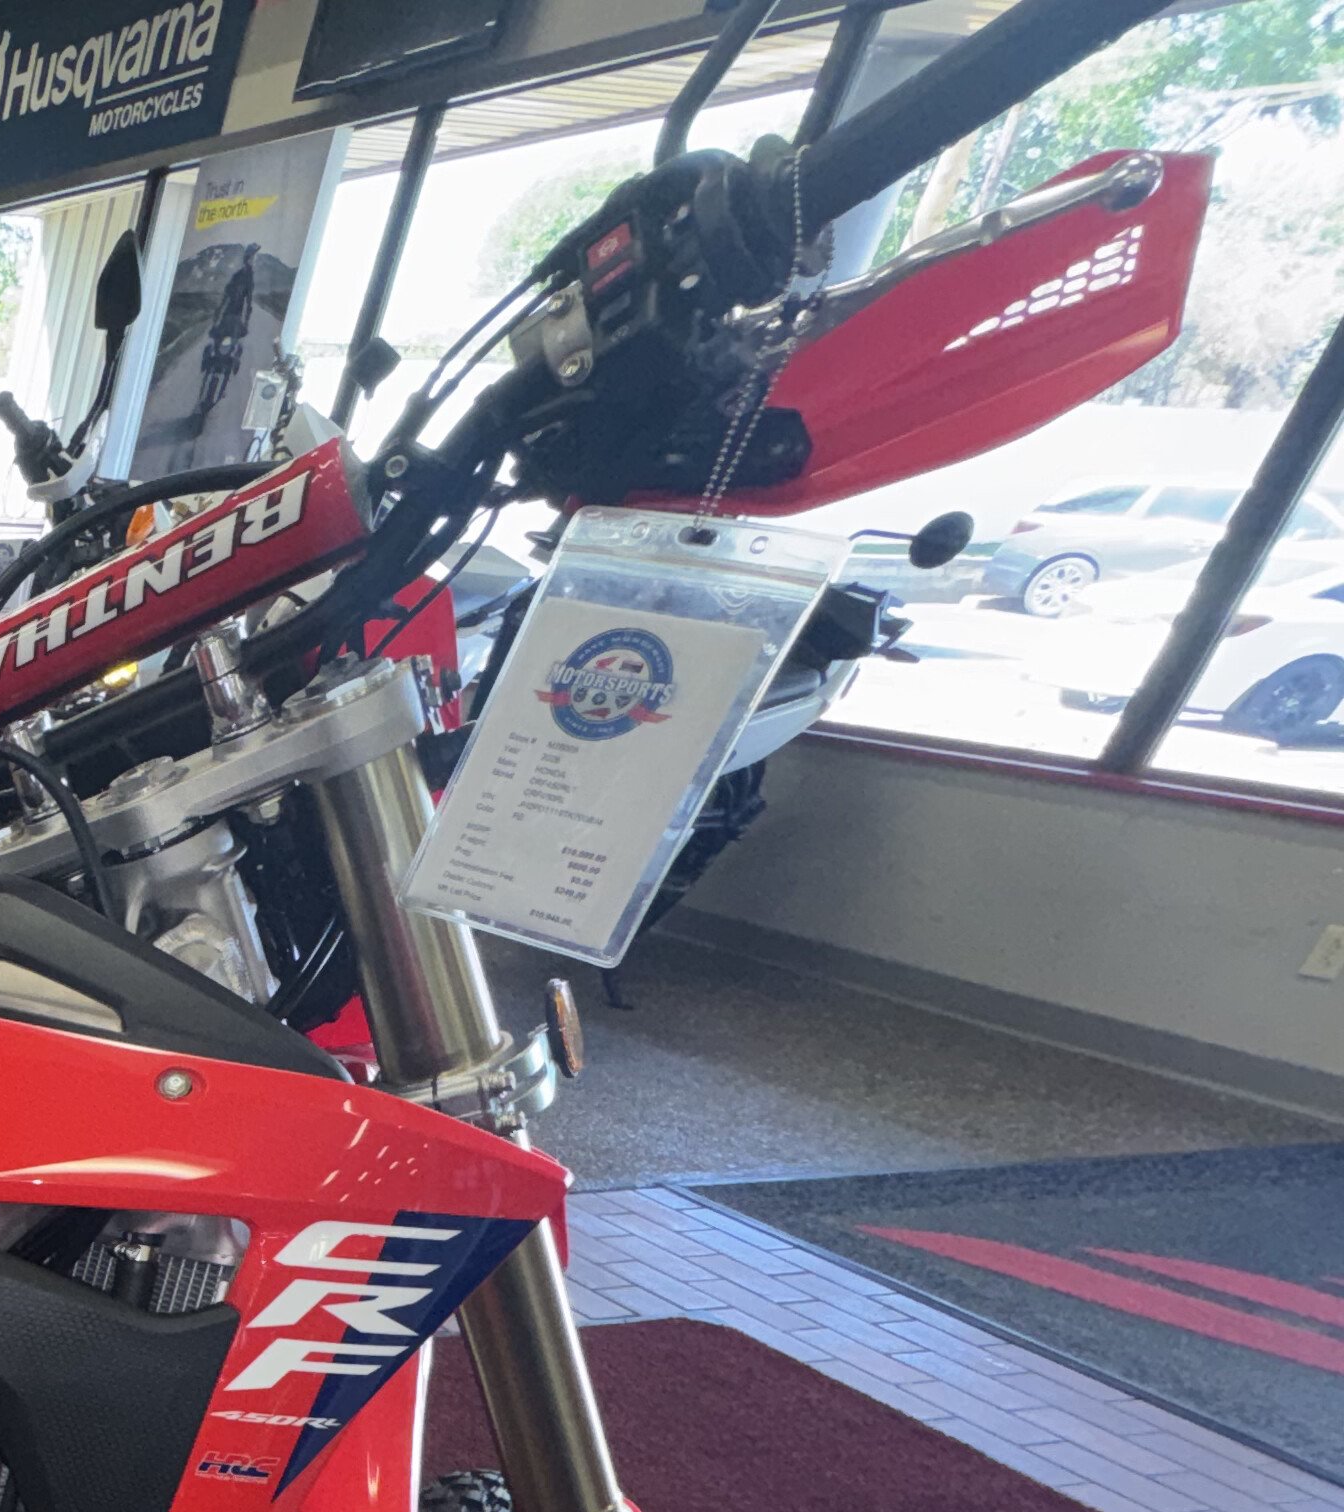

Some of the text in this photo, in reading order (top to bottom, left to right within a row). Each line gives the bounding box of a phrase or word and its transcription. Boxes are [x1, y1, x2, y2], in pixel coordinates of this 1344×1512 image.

[2, 0, 223, 120] Husqvarna
[88, 82, 204, 137] MOTORCYCLES
[547, 661, 675, 706] MOTORSPORTS
[223, 1220, 462, 1391] CRF
[209, 1409, 342, 1430] 450RL
[196, 1450, 281, 1478] HRC
